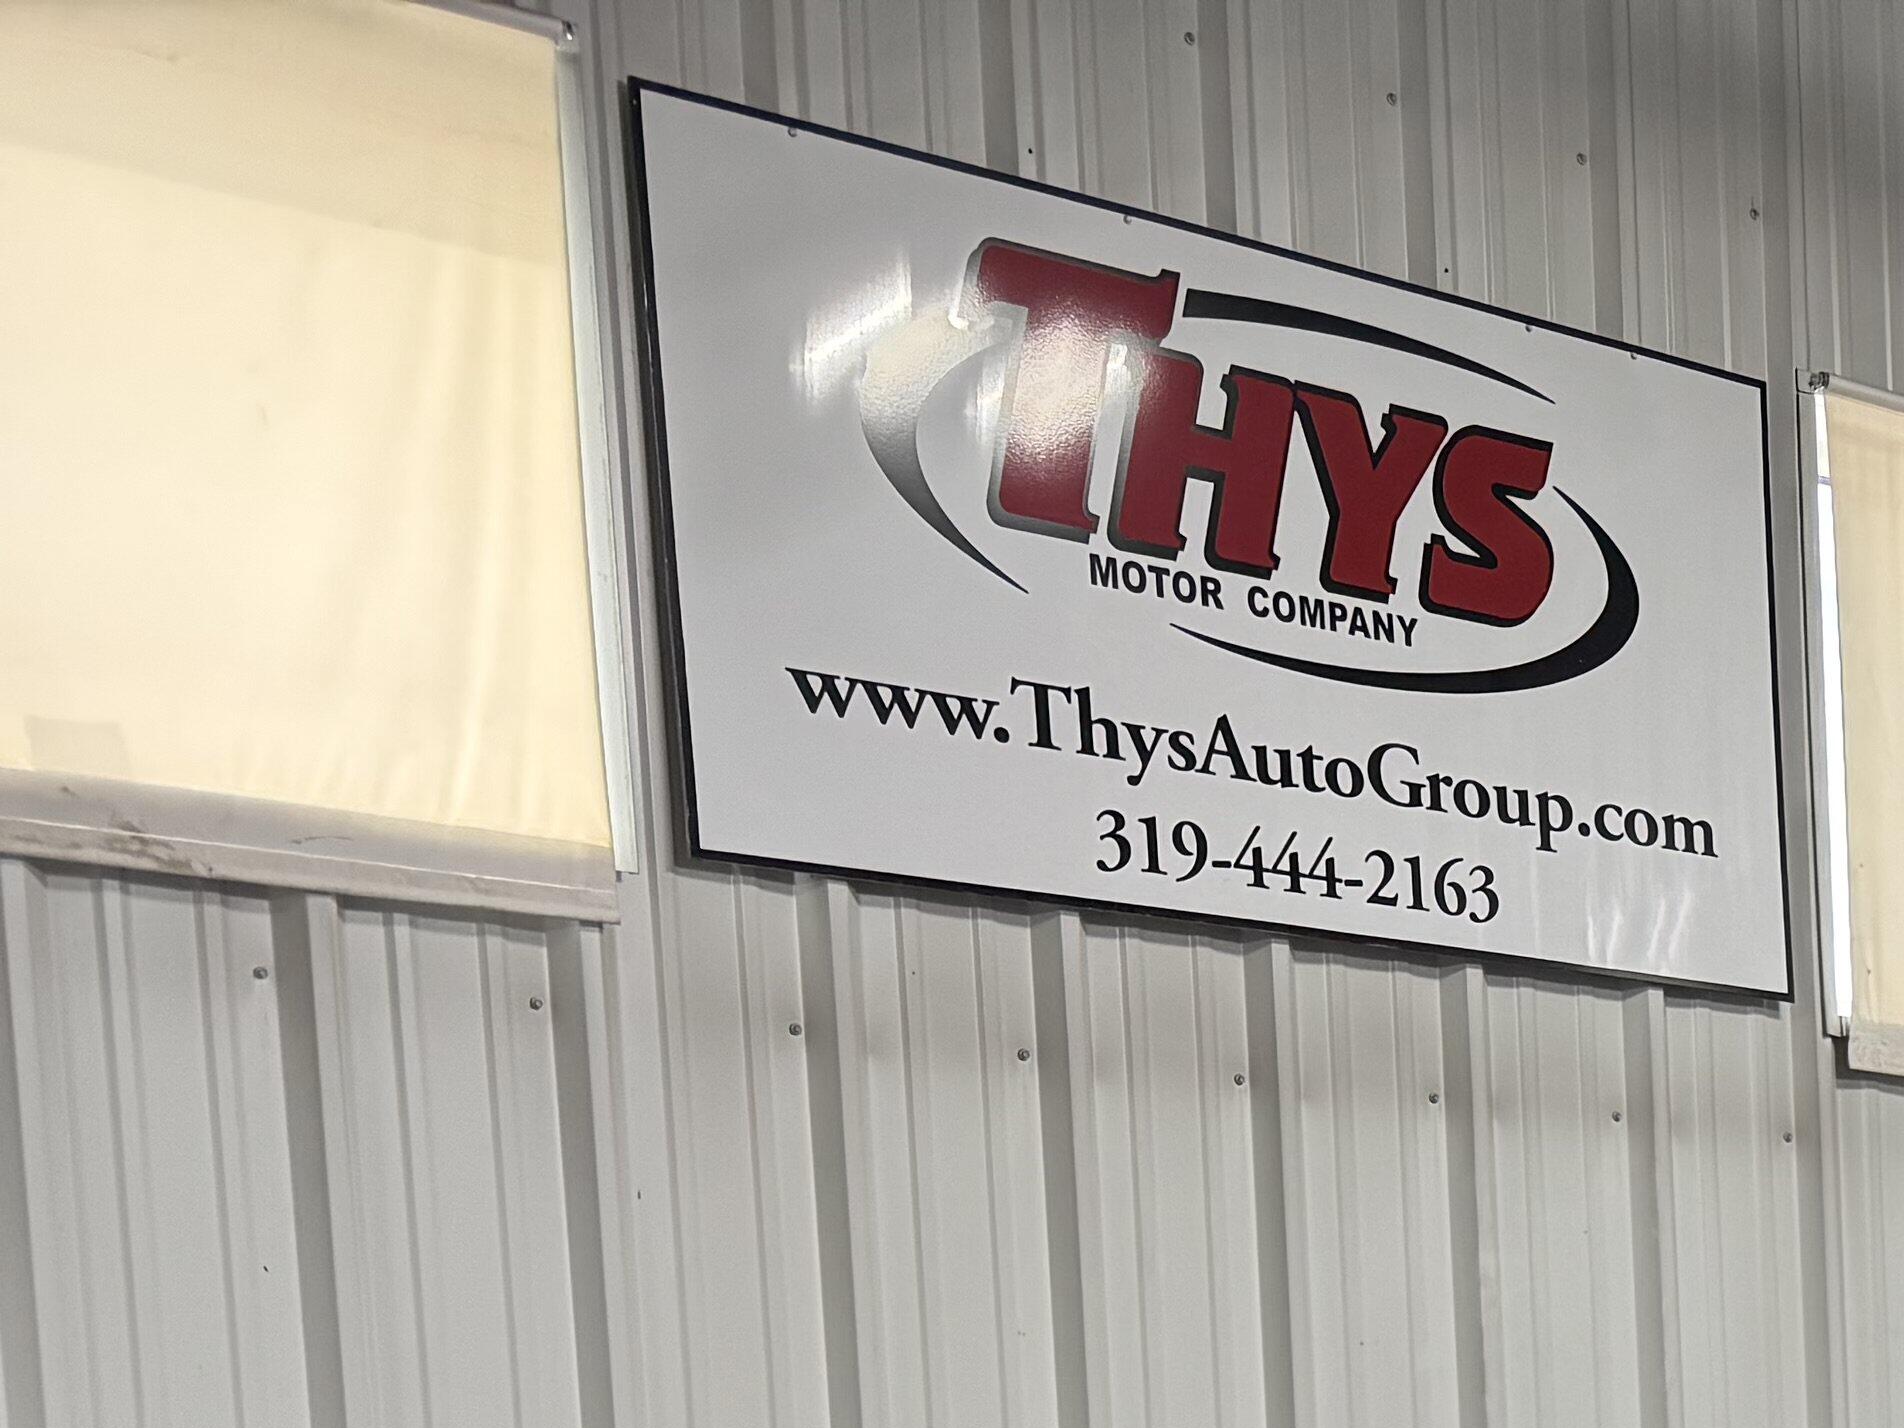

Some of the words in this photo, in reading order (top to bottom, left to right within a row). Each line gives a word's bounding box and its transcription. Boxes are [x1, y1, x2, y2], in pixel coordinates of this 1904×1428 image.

[952, 235, 1556, 627] THYS
[1088, 553, 1223, 609] MOTOR
[1247, 584, 1418, 648] COMPANY
[785, 665, 1718, 859] www.ThysAutoGroup.com
[1095, 810, 1501, 924] 319-444-2163
